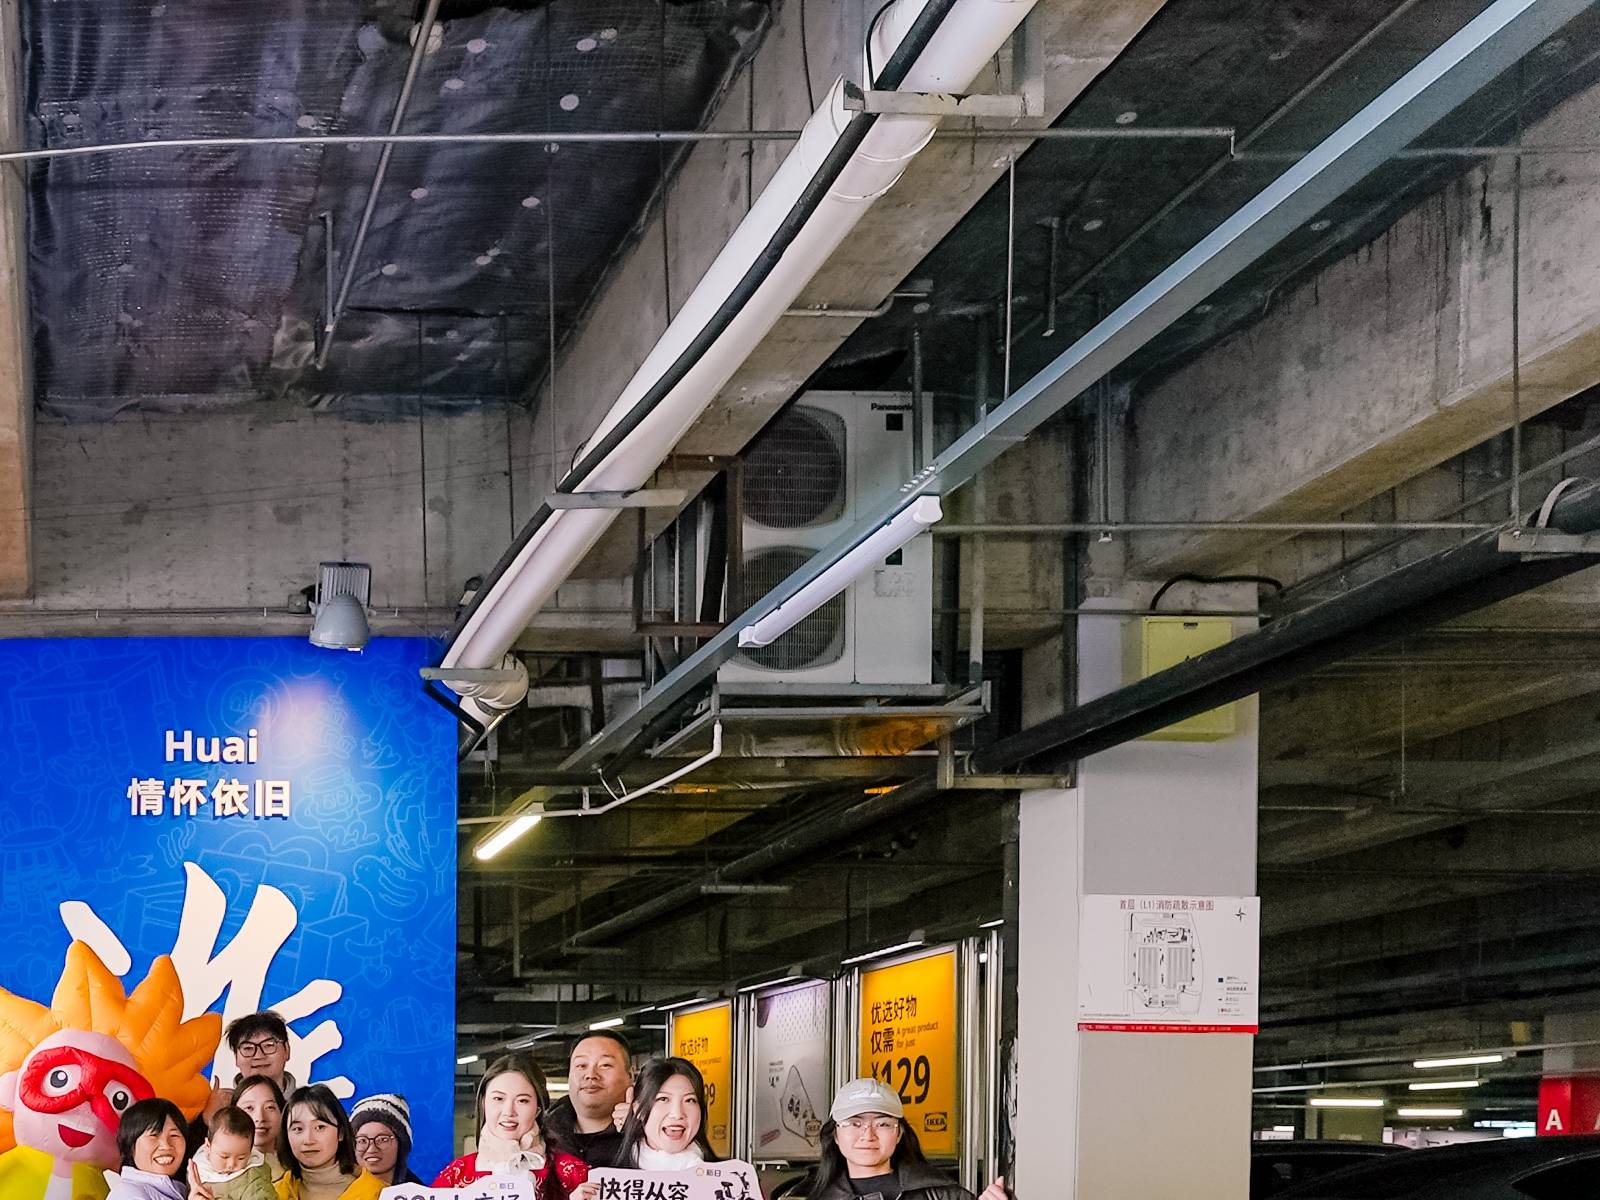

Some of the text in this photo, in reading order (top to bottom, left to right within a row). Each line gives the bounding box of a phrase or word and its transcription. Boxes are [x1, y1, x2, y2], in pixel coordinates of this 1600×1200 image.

[871, 402, 913, 411] Panasoni
[165, 729, 258, 763] Huai
[127, 777, 290, 818] 情怀依旧
[870, 995, 917, 1025] 优选好物
[870, 1027, 895, 1055] 仅需
[917, 1021, 939, 1034] product
[1545, 1109, 1563, 1131] A
